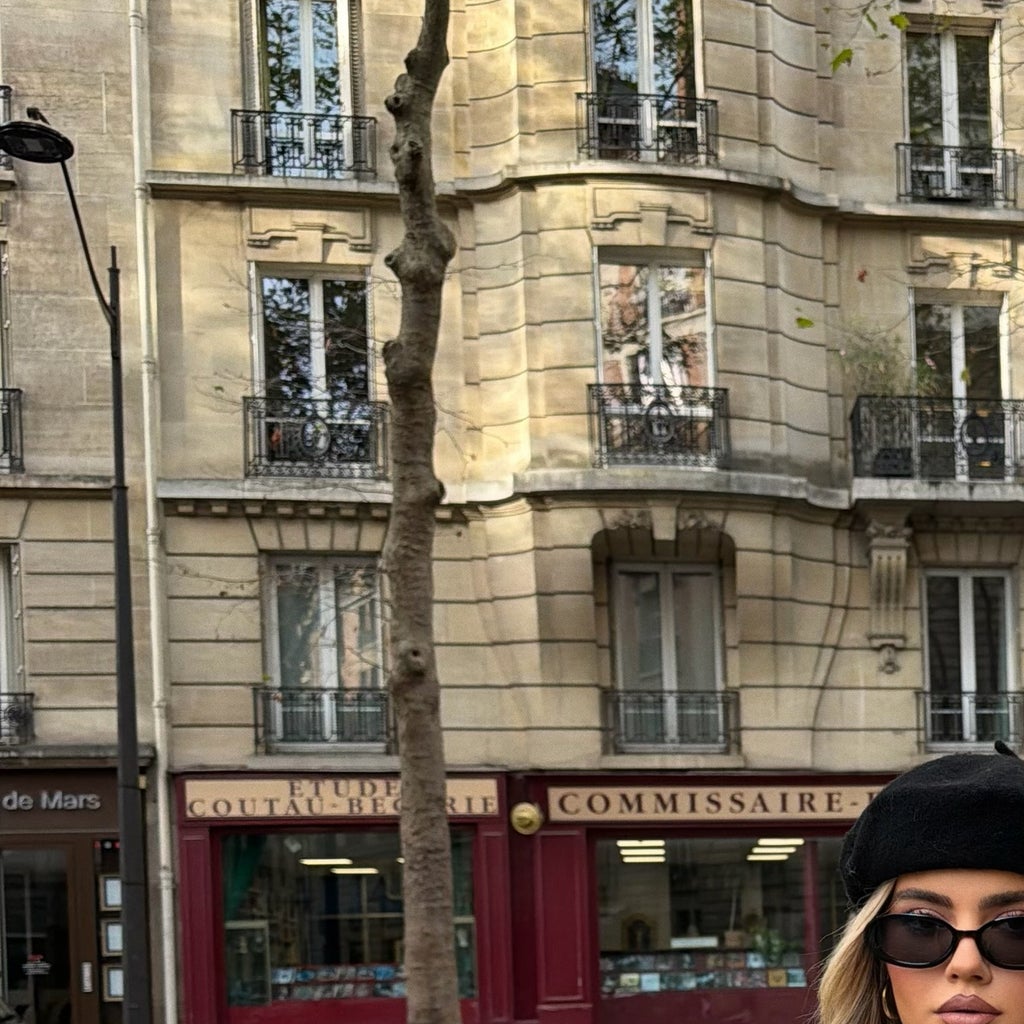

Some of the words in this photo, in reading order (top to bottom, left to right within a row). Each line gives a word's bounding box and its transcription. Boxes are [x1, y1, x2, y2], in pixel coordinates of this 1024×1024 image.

[289, 780, 400, 798] ETUDE
[2, 790, 34, 810] de
[40, 790, 101, 810] Mars
[189, 797, 497, 817] COUTAU-BERIE
[558, 792, 878, 815] COMMISSAIRE-
